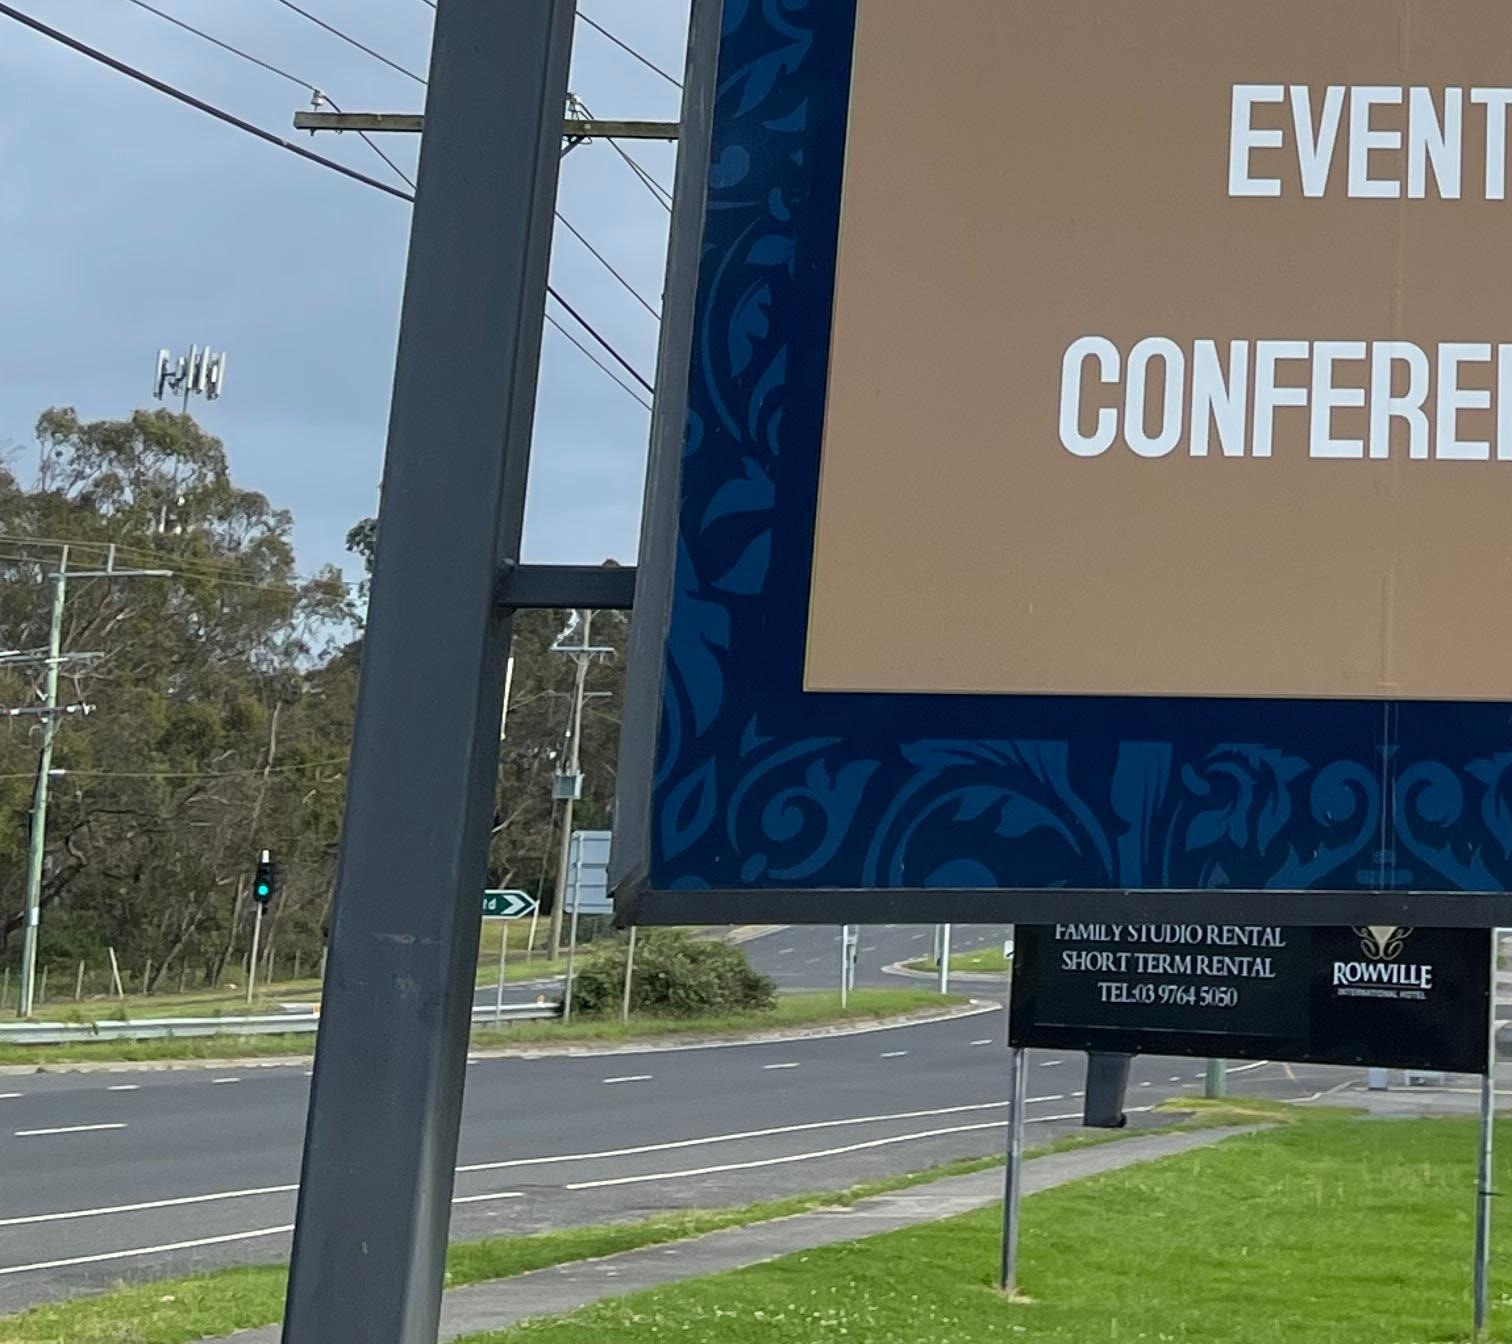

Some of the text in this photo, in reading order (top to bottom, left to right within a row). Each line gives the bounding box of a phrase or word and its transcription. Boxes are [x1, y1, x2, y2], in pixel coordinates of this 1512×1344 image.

[1055, 923, 1287, 948] FAMILY STUDIO RENTAL
[1061, 950, 1277, 978] SHORT TERM RENTAL
[1332, 961, 1433, 989] ROWVILLE
[1157, 984, 1197, 1005] 9764
[1199, 985, 1239, 1007] 5050
